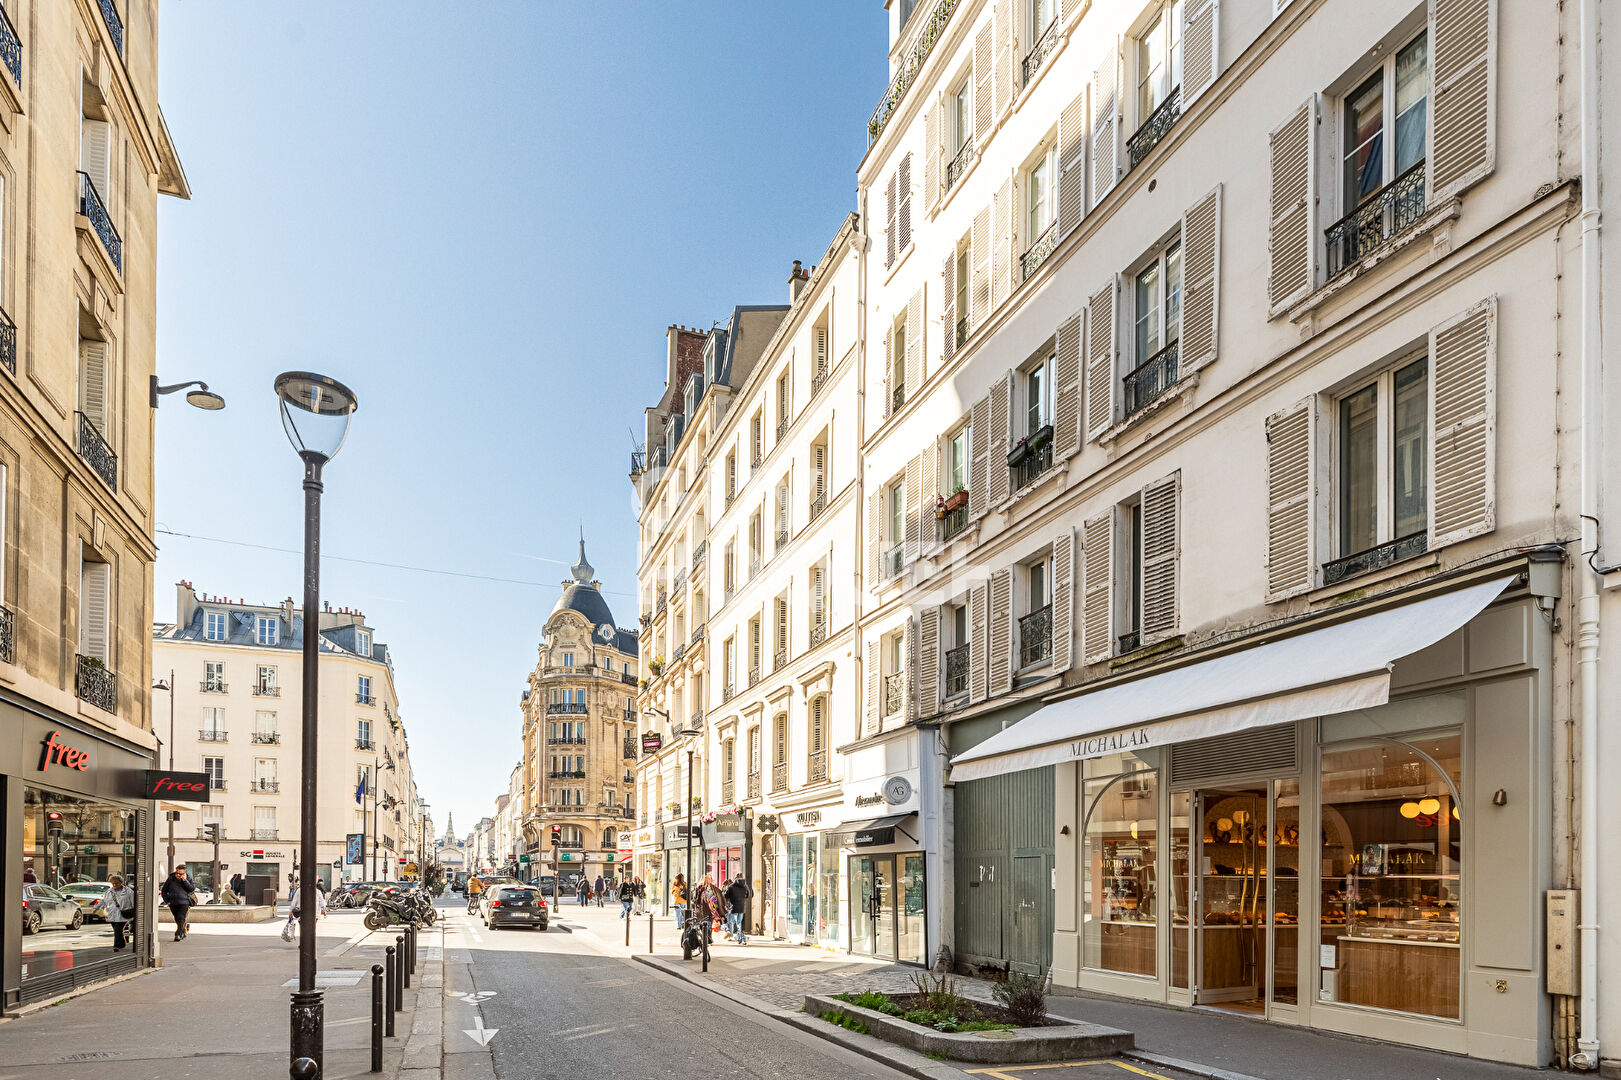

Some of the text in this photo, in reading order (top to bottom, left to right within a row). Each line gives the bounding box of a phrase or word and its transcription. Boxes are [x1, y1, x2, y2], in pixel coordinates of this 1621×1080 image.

[1070, 728, 1149, 756] MICHALAK
[43, 731, 90, 772] free
[153, 777, 206, 793] free
[892, 786, 905, 796] AG
[1349, 852, 1425, 864] MIALAK
